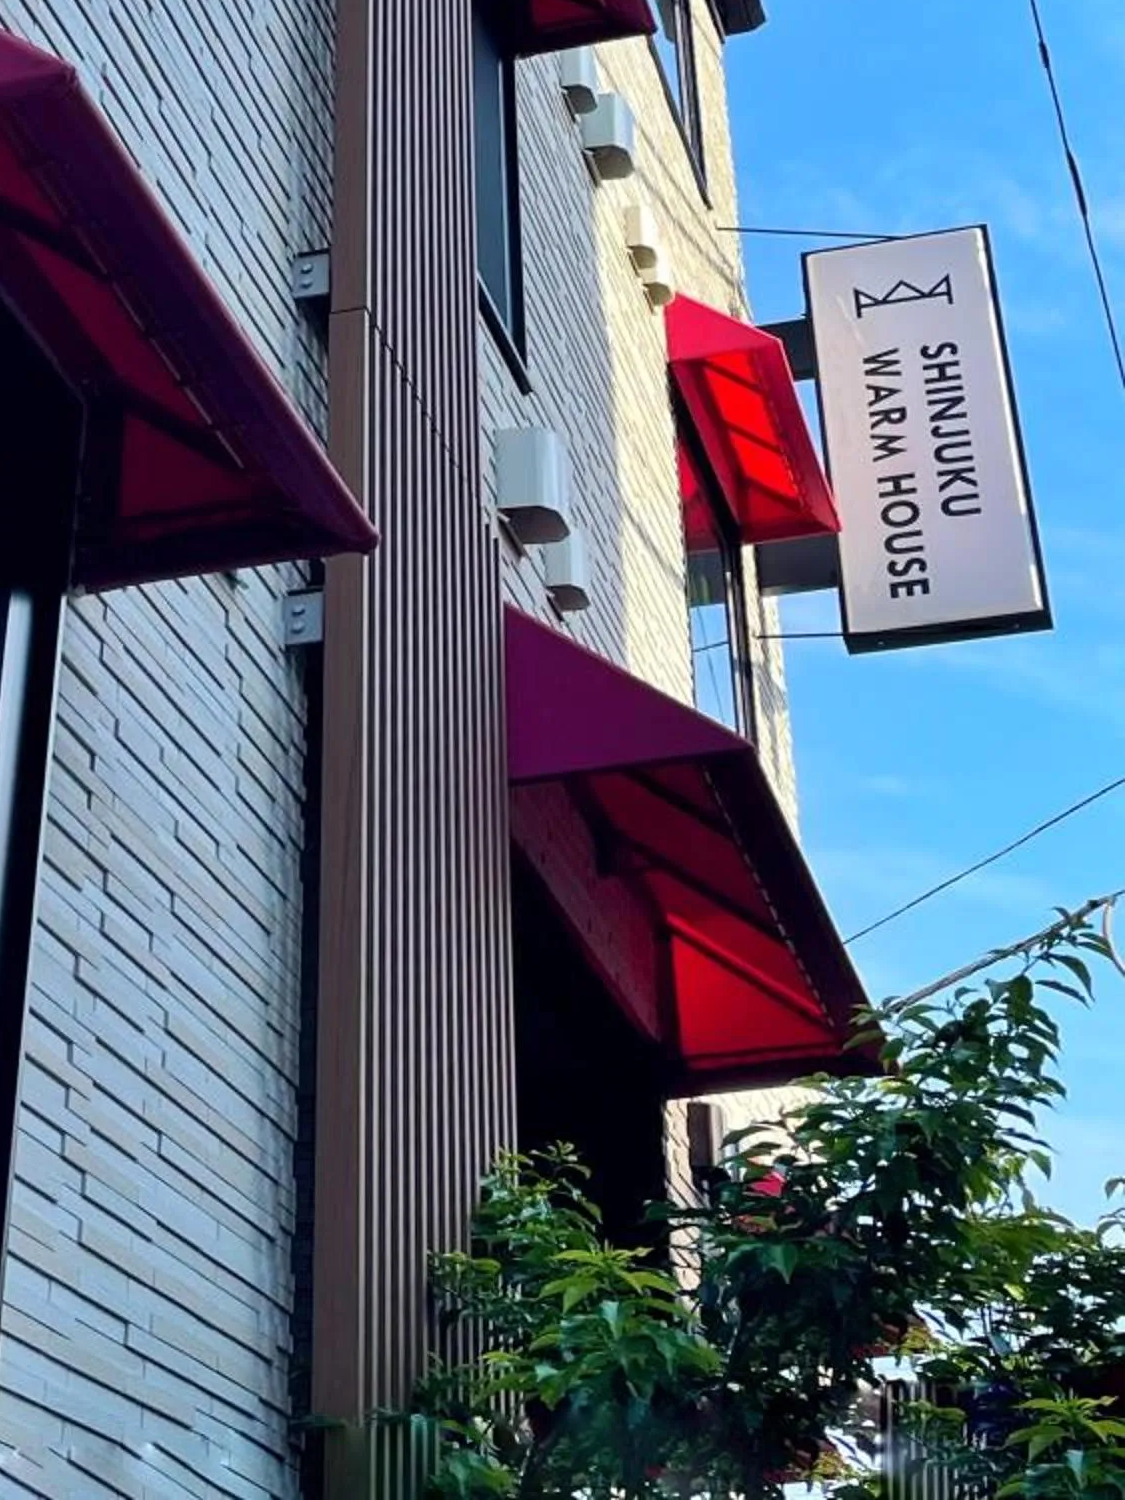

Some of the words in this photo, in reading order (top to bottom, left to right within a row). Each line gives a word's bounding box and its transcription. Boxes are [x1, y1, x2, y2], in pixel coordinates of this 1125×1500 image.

[863, 347, 907, 462] WARM
[920, 341, 982, 518] SHINJUKU
[877, 473, 930, 599] HOUSE
